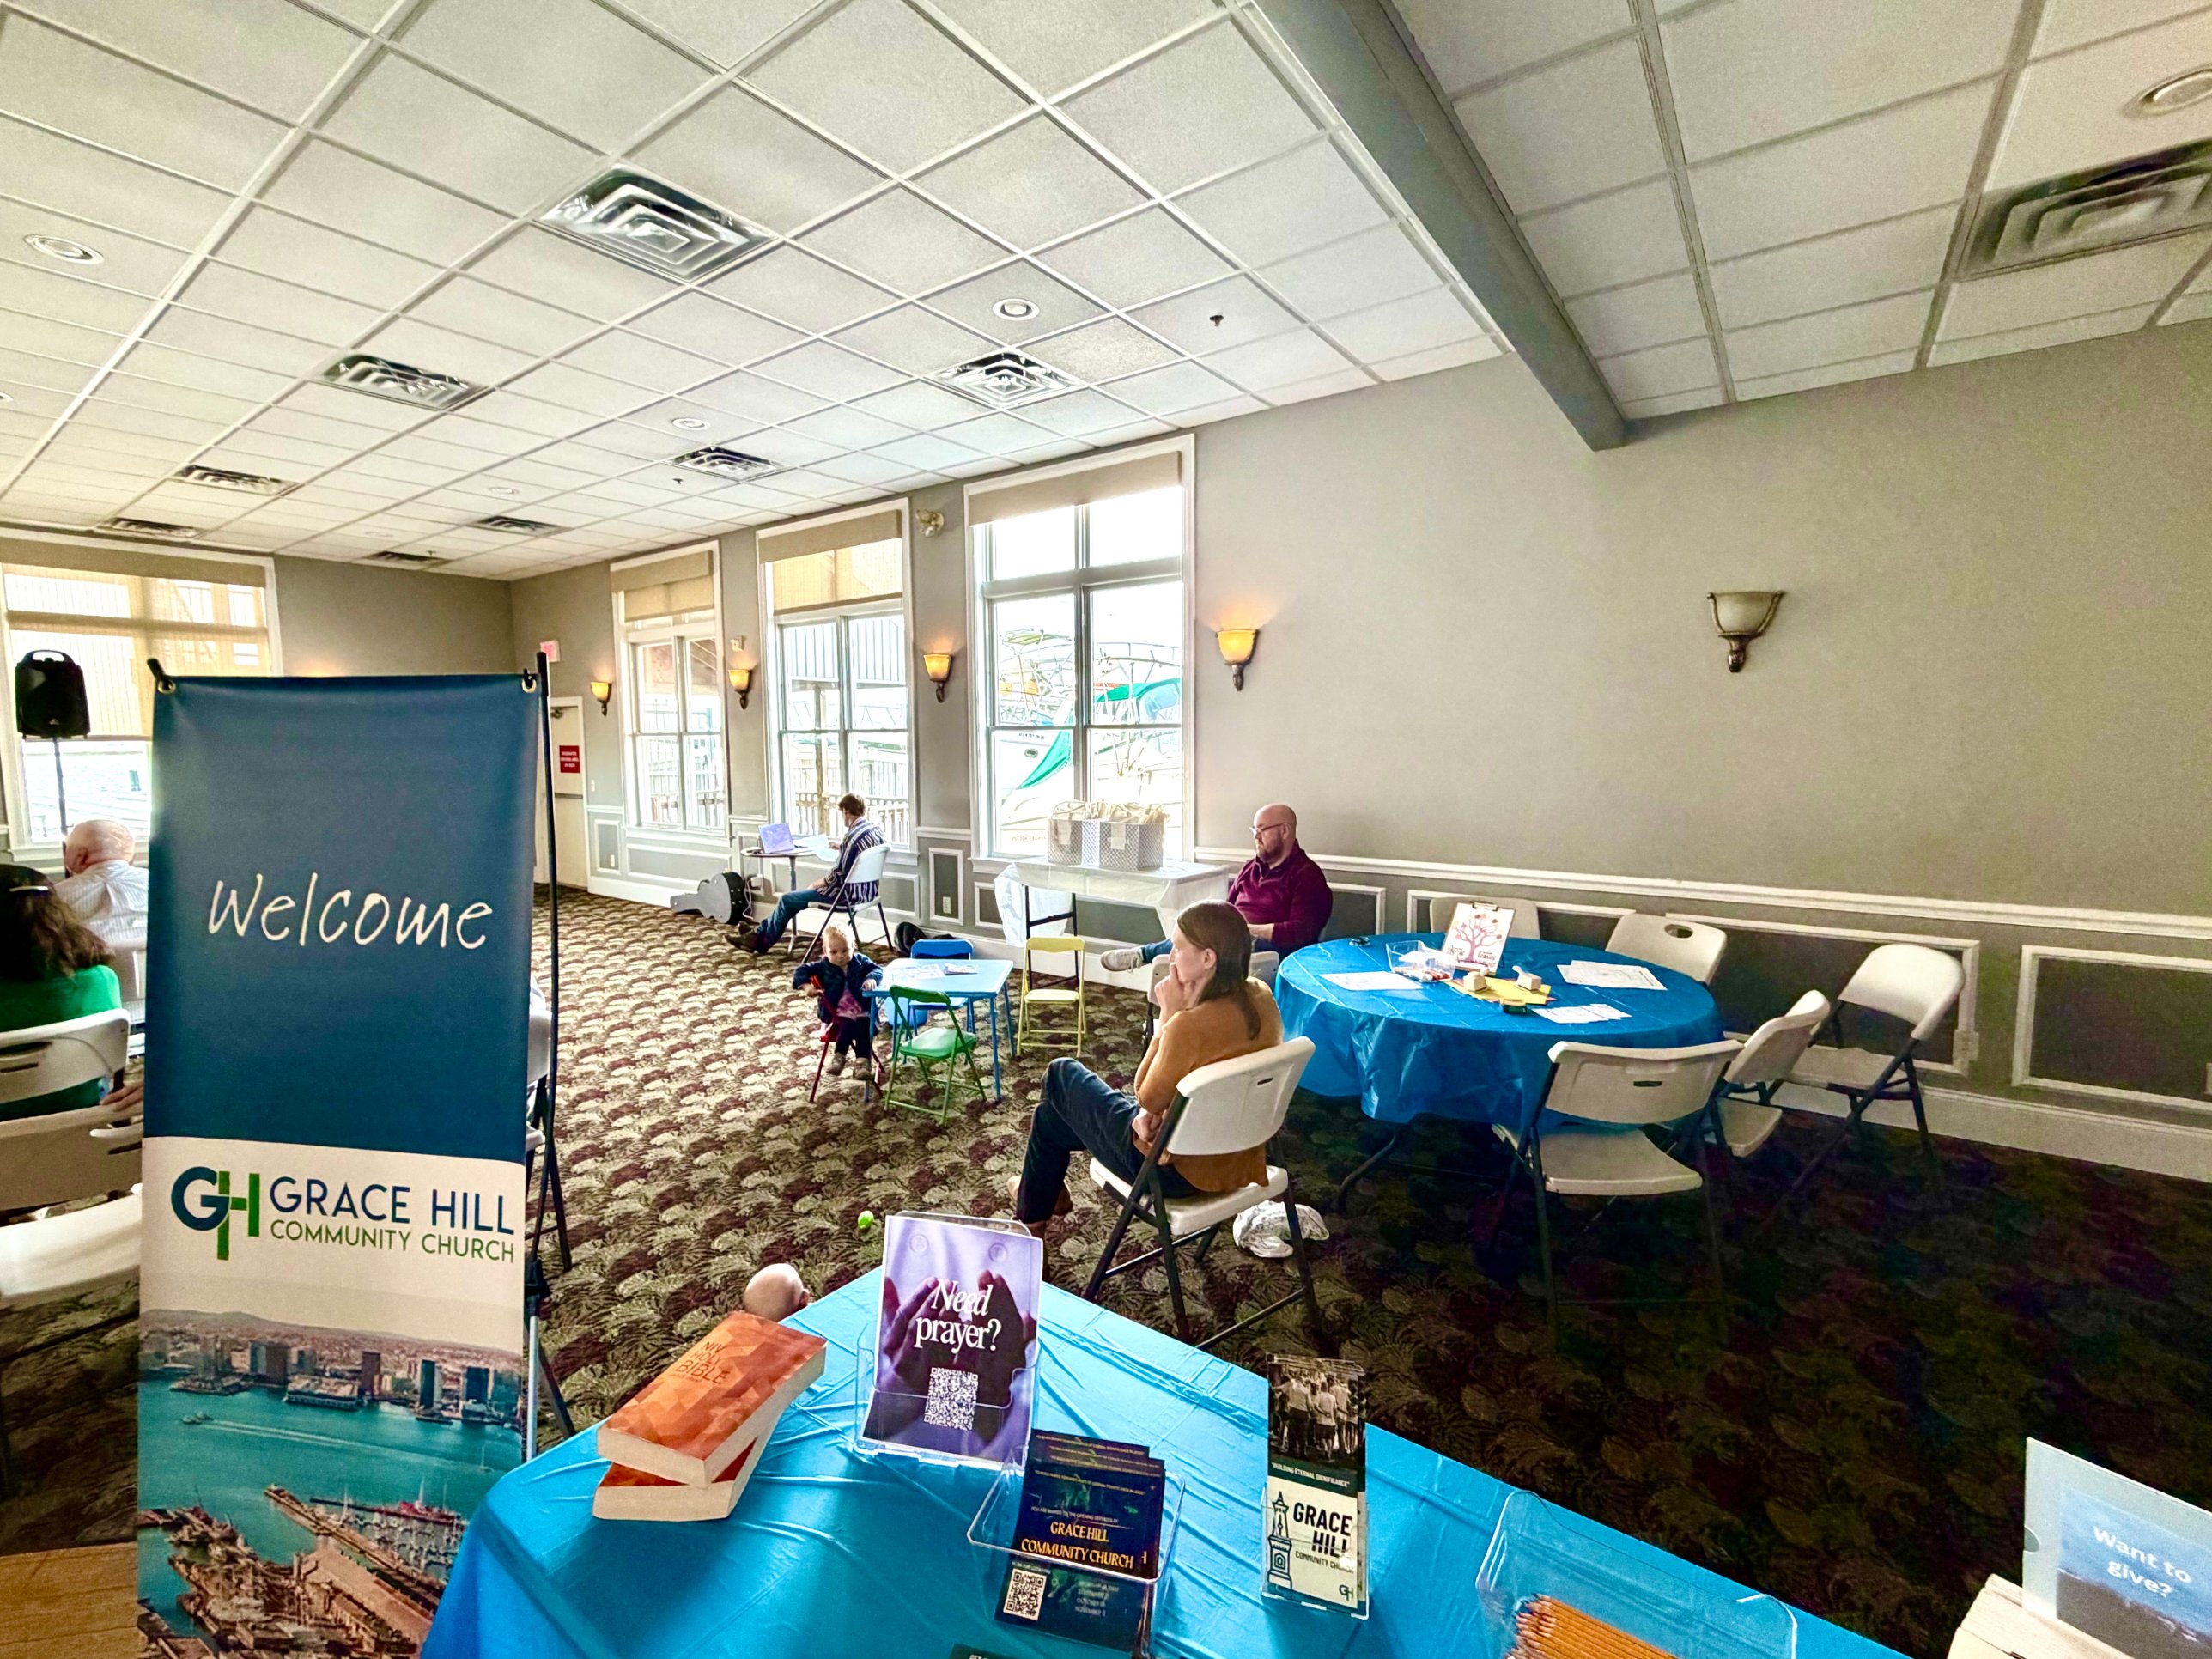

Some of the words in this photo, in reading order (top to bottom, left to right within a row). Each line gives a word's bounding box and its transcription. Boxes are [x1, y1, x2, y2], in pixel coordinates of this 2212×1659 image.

[208, 872, 493, 949] Welcome
[270, 1176, 411, 1224] GRACE
[431, 1188, 515, 1236] HILL
[270, 1219, 411, 1251] COMMUNITY
[421, 1233, 515, 1264] CHURCH
[931, 1278, 994, 1316] Need
[705, 1341, 727, 1353] NIV
[914, 1316, 1002, 1354] prayer?
[675, 1359, 731, 1384] BIBLE
[690, 1351, 721, 1365] HOLY
[1050, 1522, 1086, 1539] GRACE
[1086, 1527, 1109, 1542] HILL
[1293, 1502, 1352, 1536] GRACE
[1021, 1538, 1090, 1561] COMMUNITY
[1089, 1550, 1134, 1569] CHURCH
[1295, 1551, 1328, 1567] COMMUNITY
[1312, 1530, 1347, 1558] HILL
[2093, 1526, 2158, 1569] Want
[2162, 1560, 2191, 1583] to
[1330, 1561, 1354, 1574] CHU
[2106, 1560, 2173, 1598] give?
